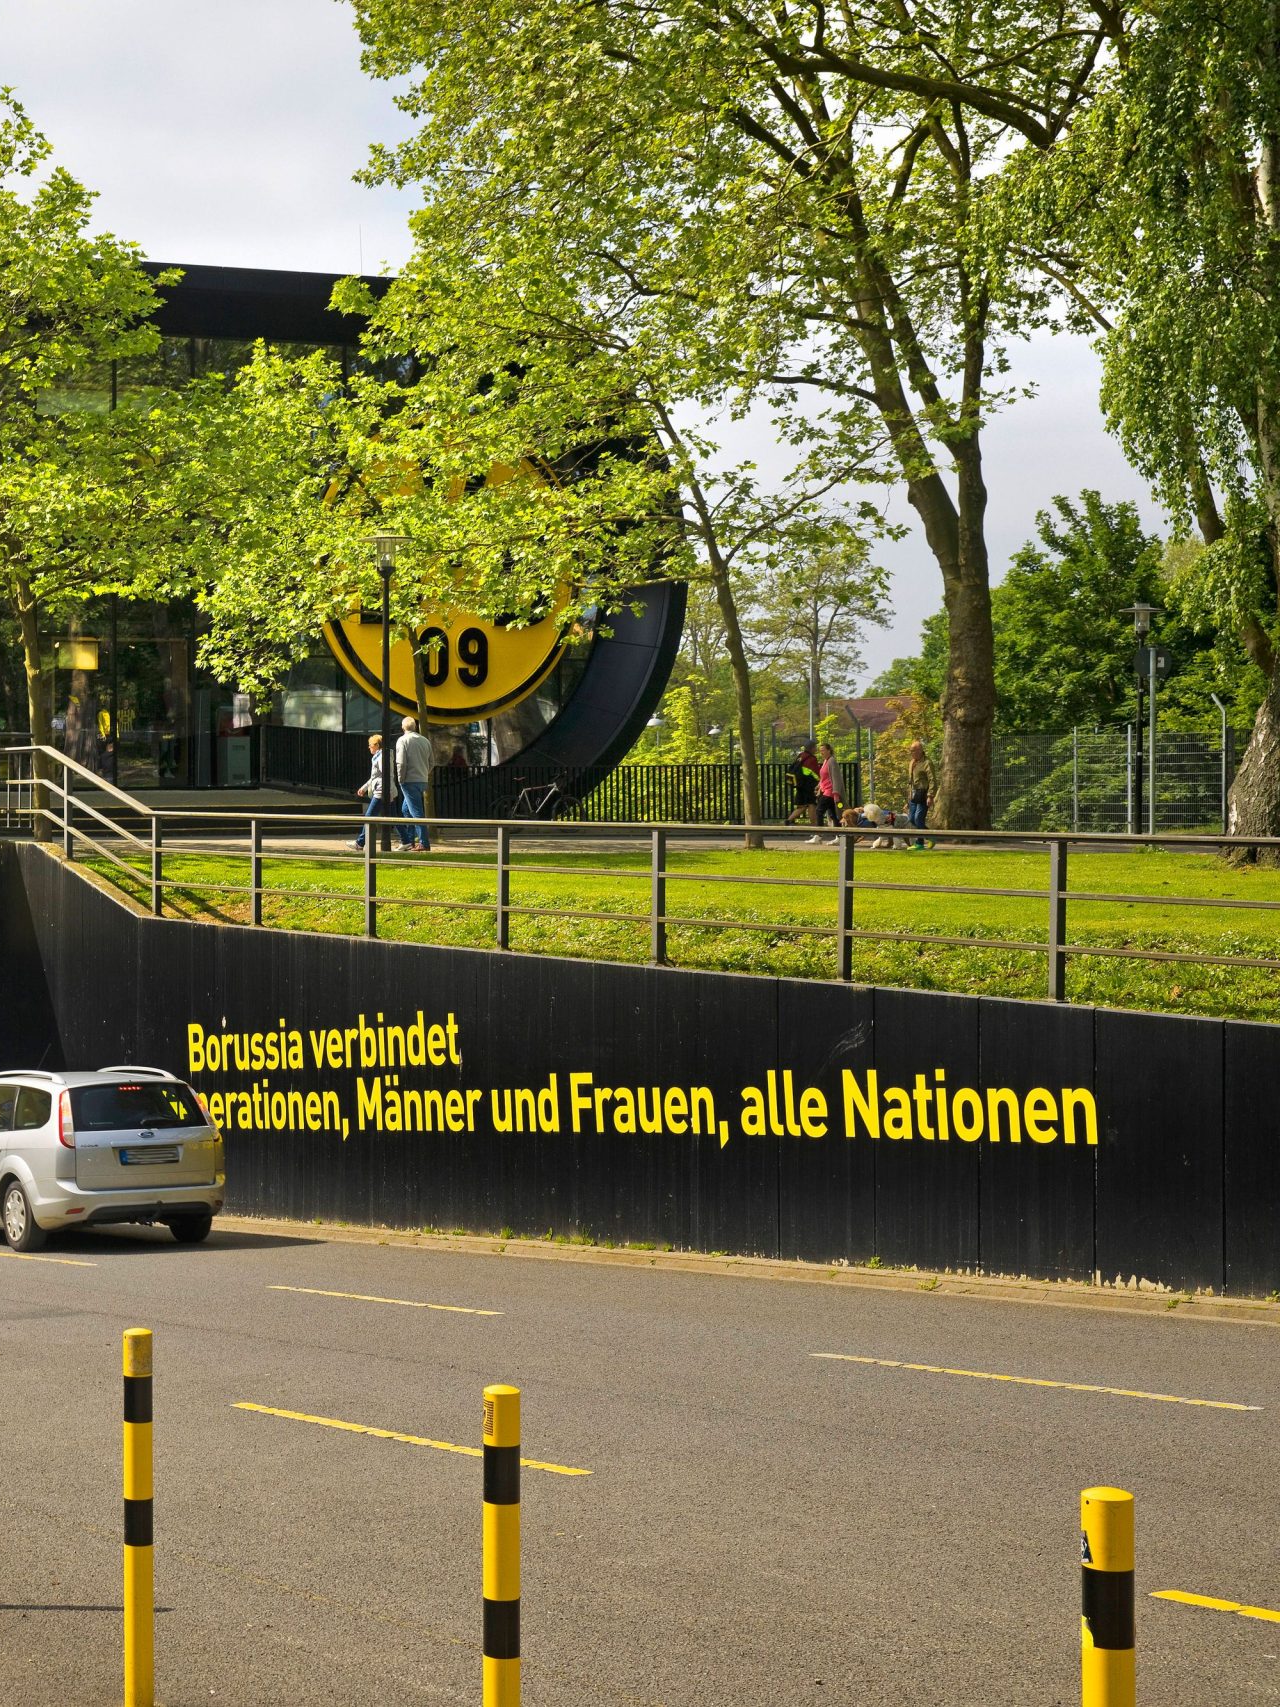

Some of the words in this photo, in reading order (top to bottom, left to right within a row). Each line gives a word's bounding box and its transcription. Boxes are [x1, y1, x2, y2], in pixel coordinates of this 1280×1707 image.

[417, 626, 489, 688] 09
[189, 1023, 304, 1073] Borussia
[309, 1010, 460, 1070] verbindet
[356, 1073, 483, 1132] Männer
[491, 1072, 560, 1134] und
[569, 1072, 729, 1147] Frauen,
[740, 1069, 828, 1138] alle
[841, 1068, 1099, 1145] Nationen
